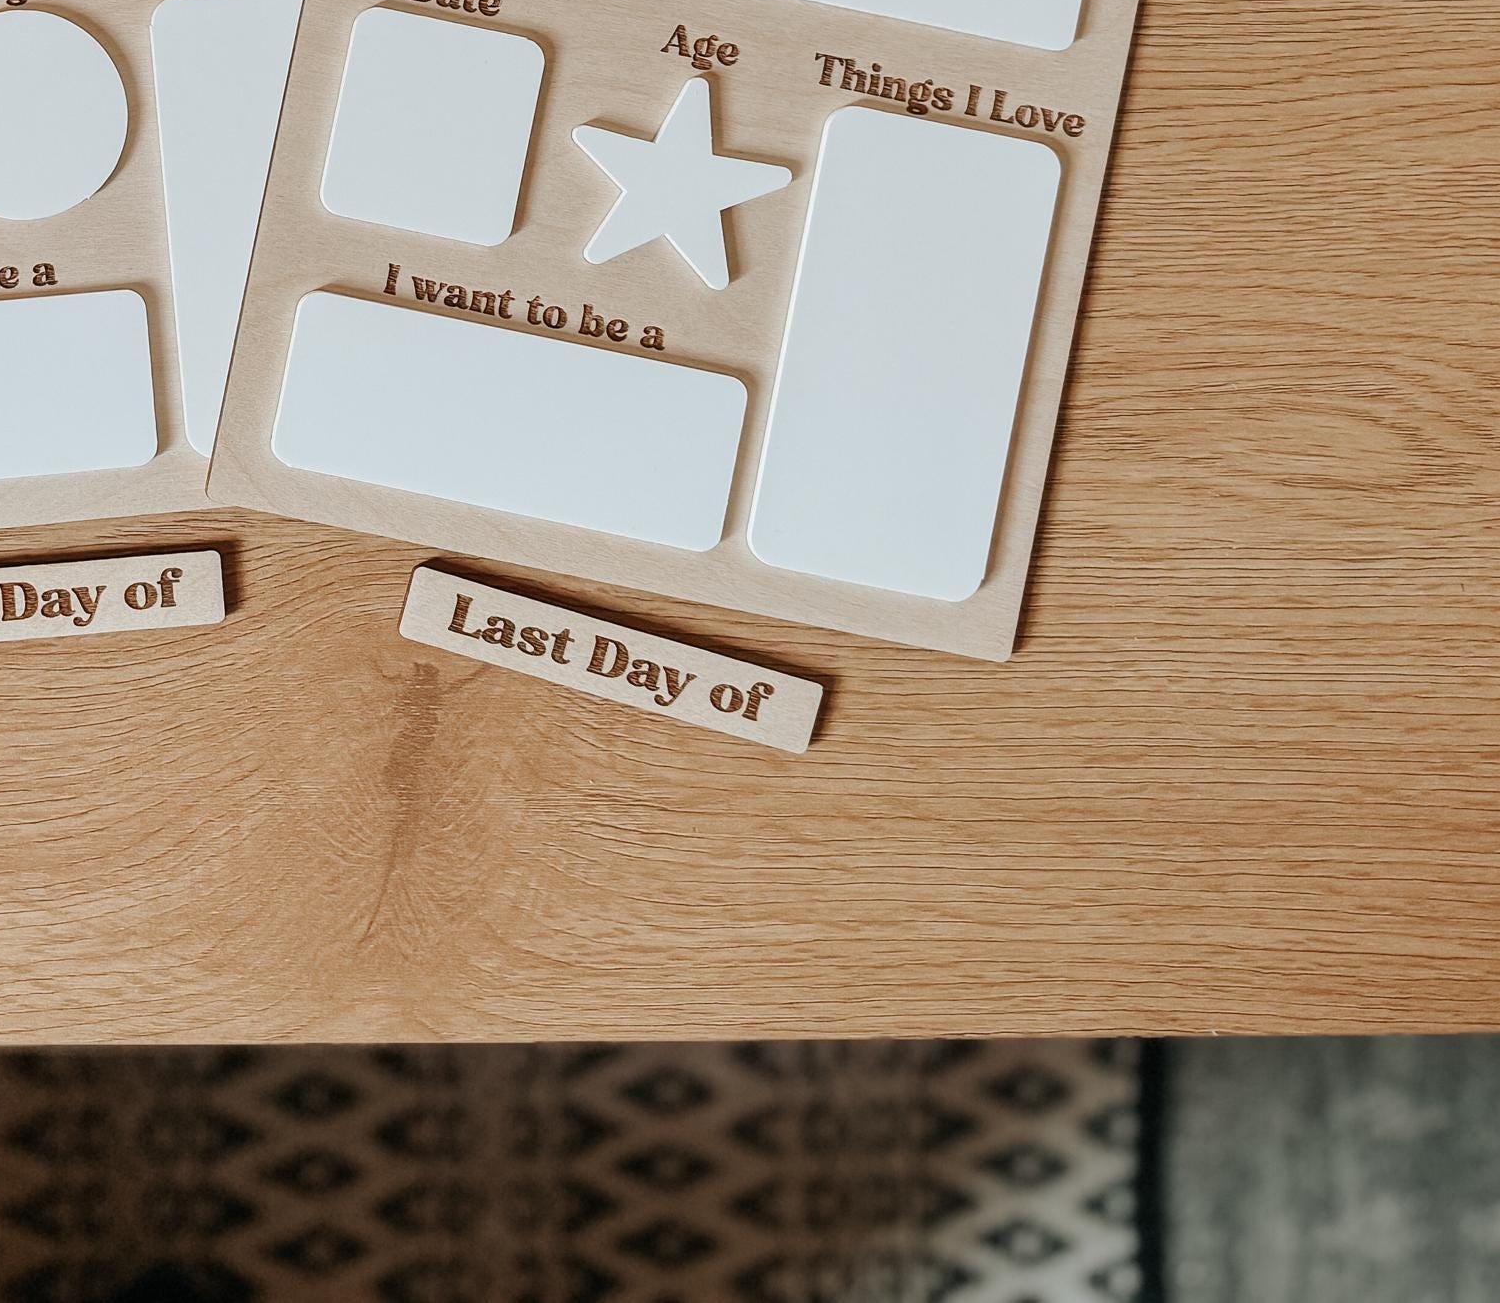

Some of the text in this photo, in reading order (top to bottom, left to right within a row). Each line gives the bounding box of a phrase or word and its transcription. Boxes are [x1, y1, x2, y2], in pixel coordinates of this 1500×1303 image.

[660, 24, 740, 70] Age
[815, 53, 1085, 138] Things I Love
[32, 260, 59, 286] a
[383, 263, 665, 350] I want to be a
[0, 581, 106, 627] Day
[124, 568, 184, 611] of
[448, 593, 775, 722] Last Day of
